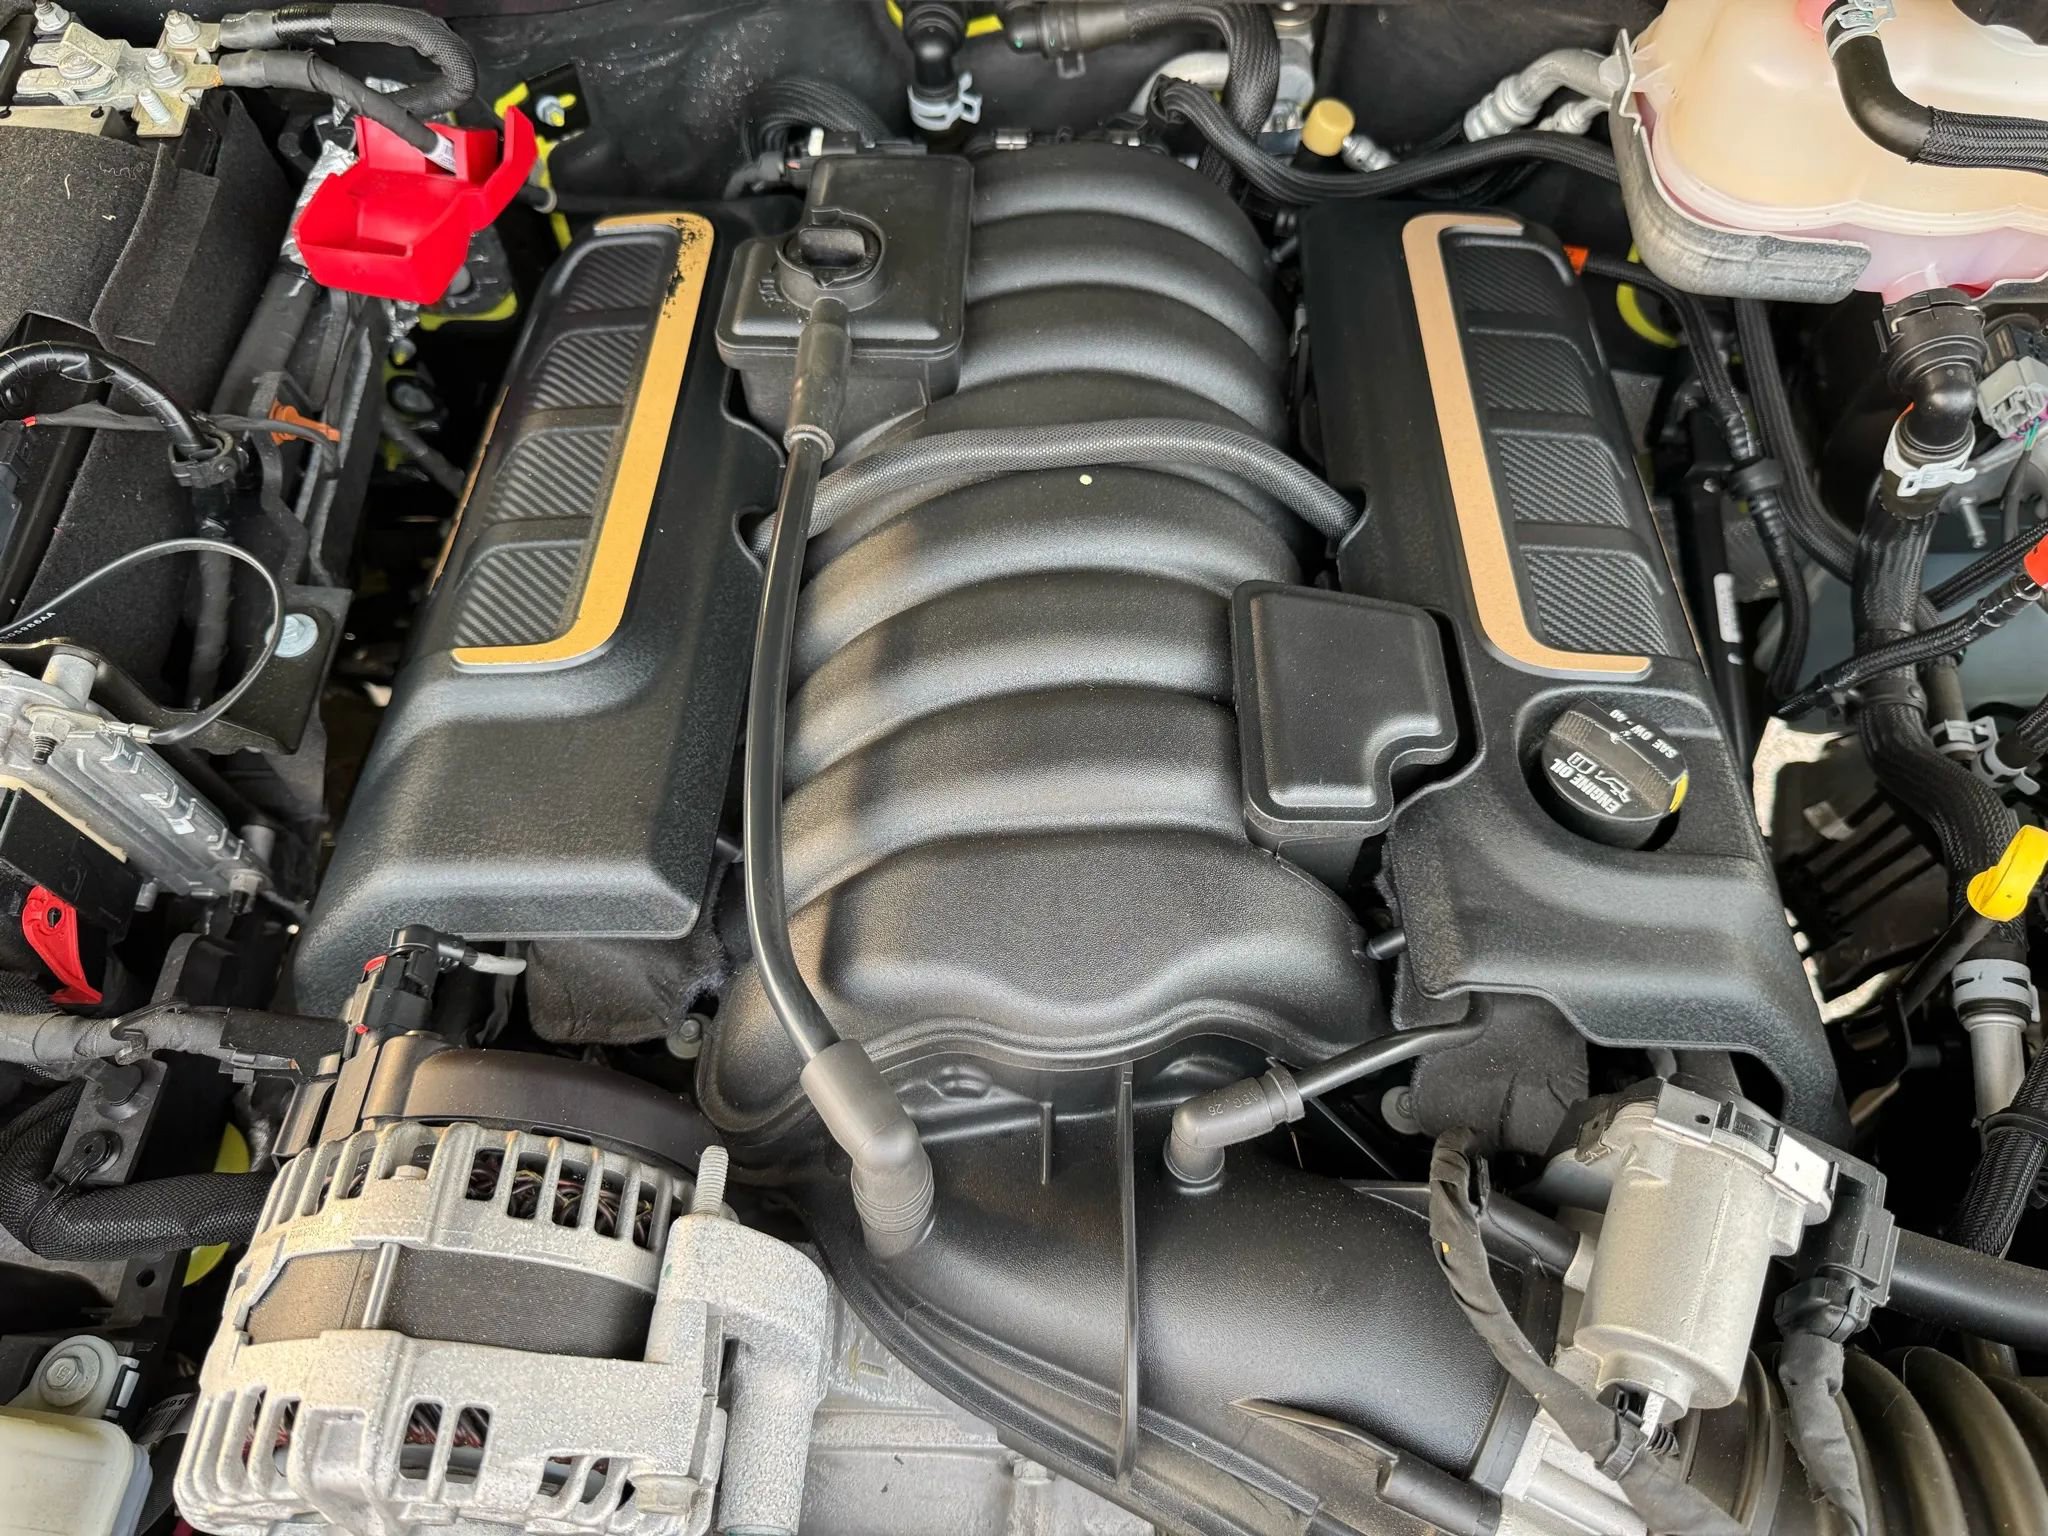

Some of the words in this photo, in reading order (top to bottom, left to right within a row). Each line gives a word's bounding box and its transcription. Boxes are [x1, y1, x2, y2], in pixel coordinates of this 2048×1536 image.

[1652, 738, 1680, 759] SAE
[1549, 758, 1576, 778] OIL
[1569, 772, 1624, 814] ENGINE
